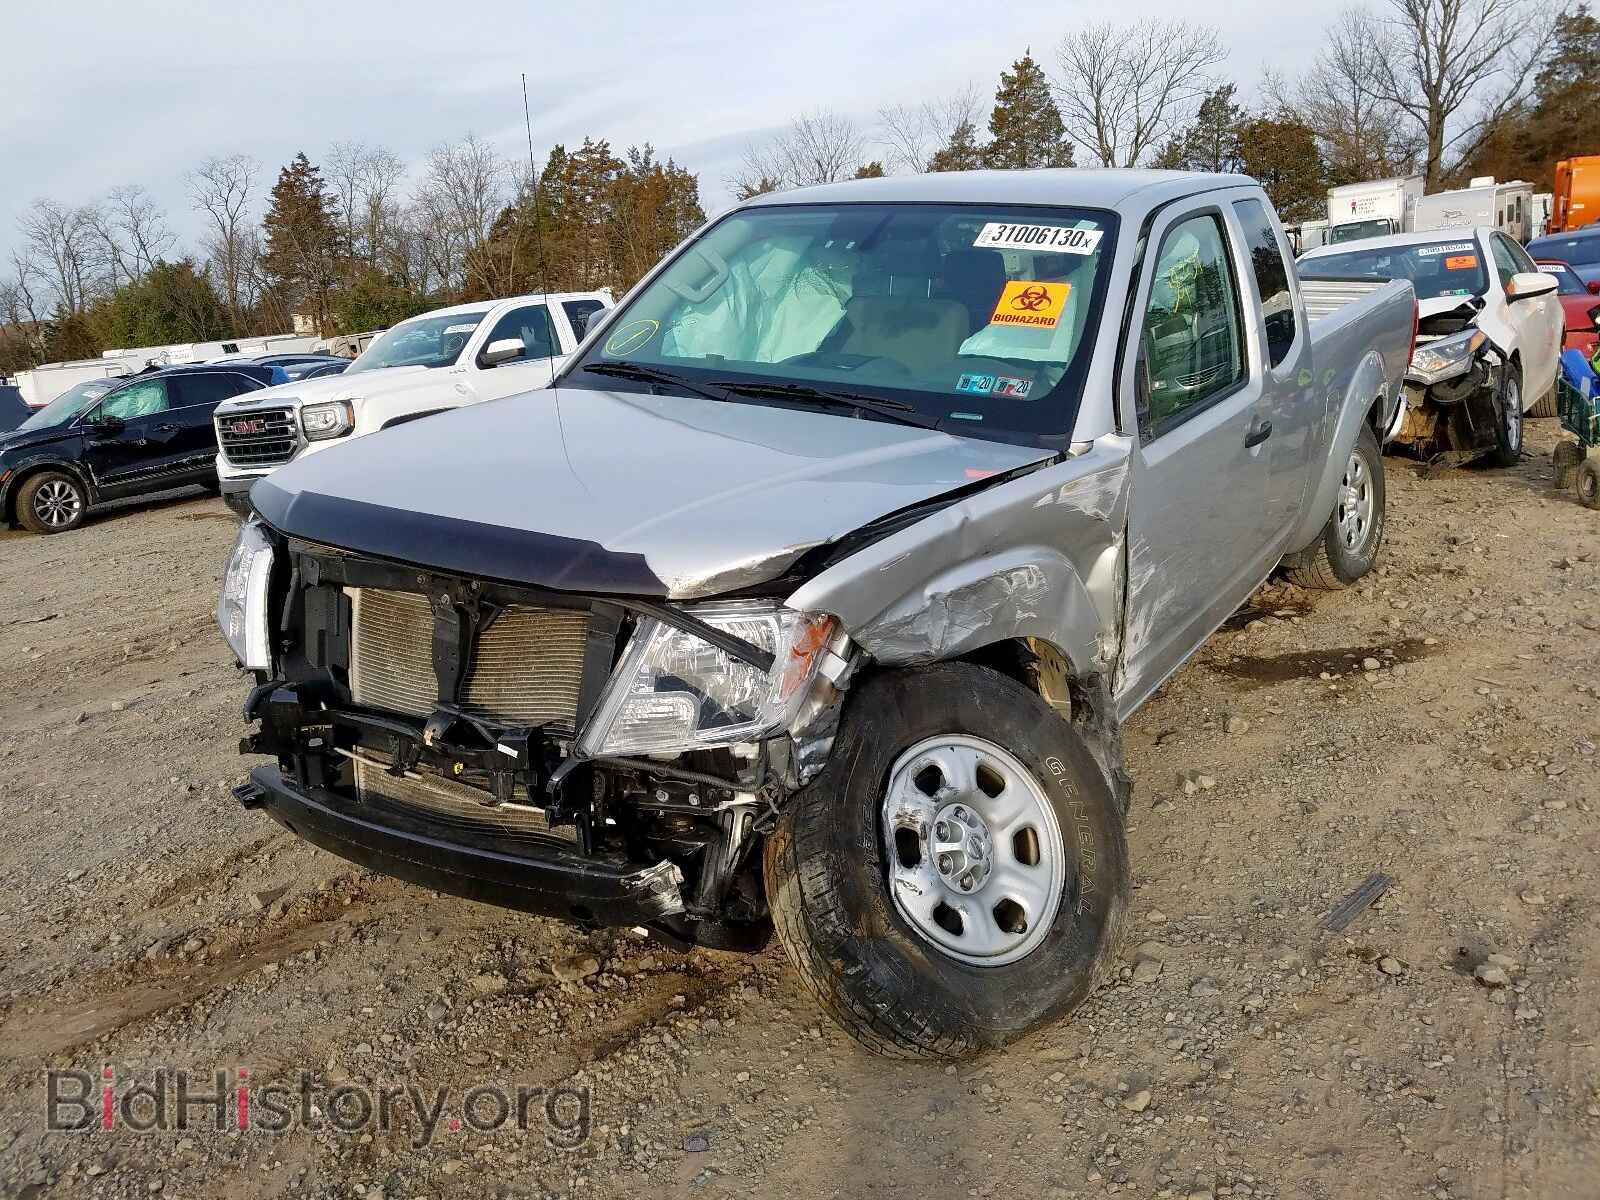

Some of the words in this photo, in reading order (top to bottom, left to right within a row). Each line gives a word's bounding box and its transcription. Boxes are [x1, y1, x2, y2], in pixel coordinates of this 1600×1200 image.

[993, 313, 1056, 326] BIOHAZARD
[979, 377, 991, 390] 20
[1017, 380, 1029, 394] 20
[232, 419, 266, 434] GMC
[1045, 756, 1097, 916] GENERAL
